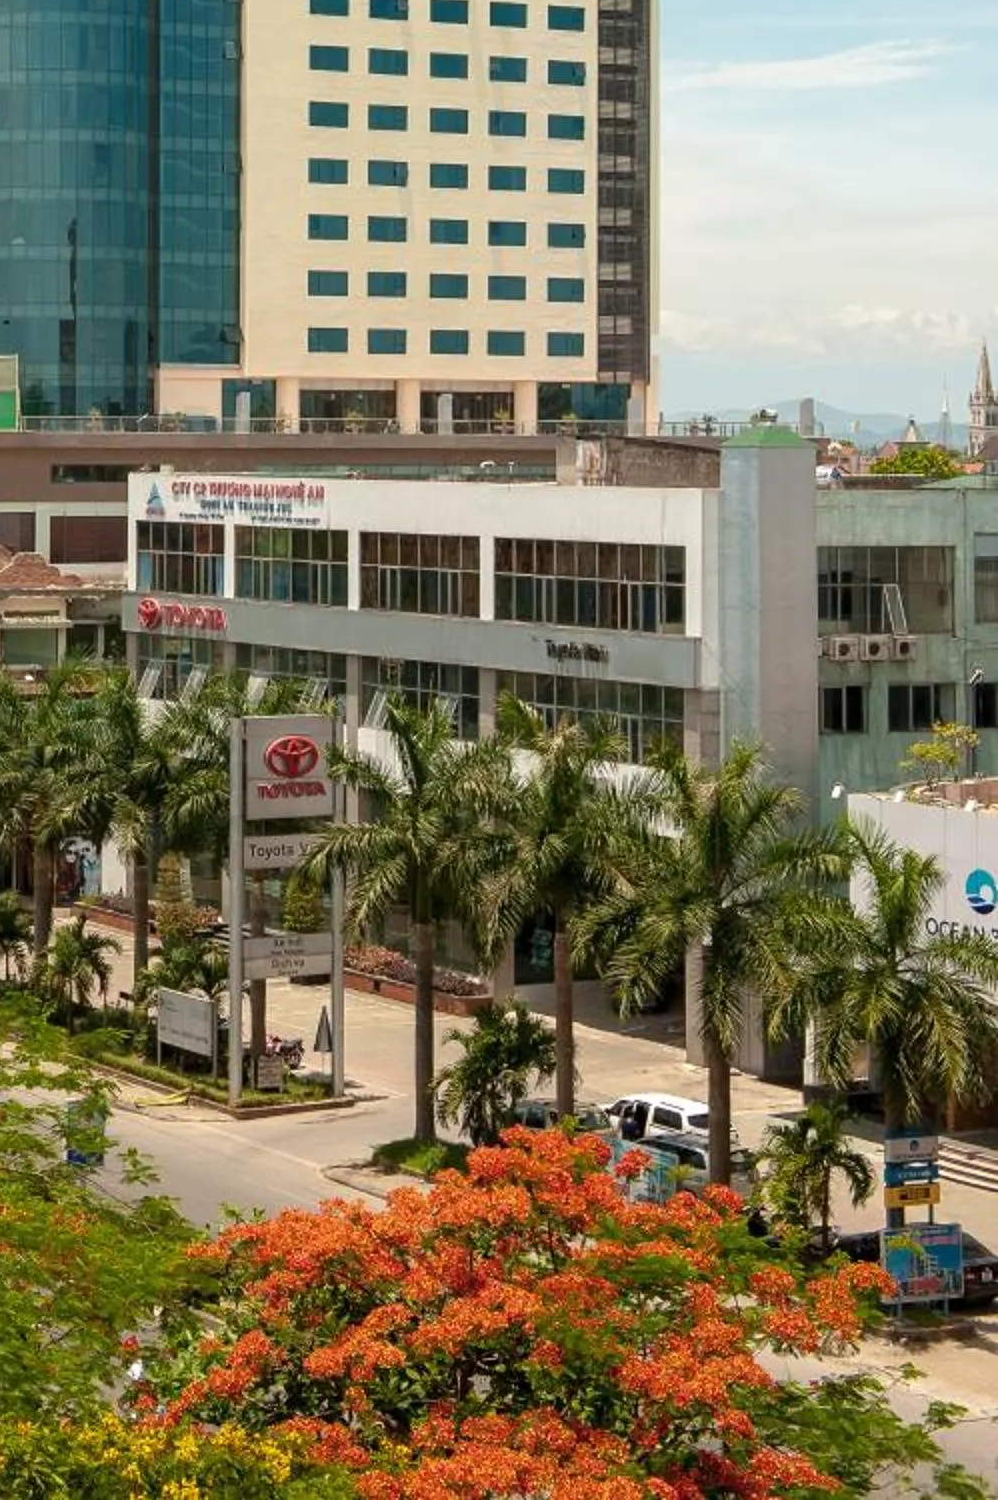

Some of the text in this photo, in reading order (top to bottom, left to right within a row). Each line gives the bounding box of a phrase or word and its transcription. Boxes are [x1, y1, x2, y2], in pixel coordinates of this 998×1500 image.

[162, 602, 227, 631] TOYOTA
[257, 781, 327, 800] TOYOTA
[249, 843, 295, 861] Toyota
